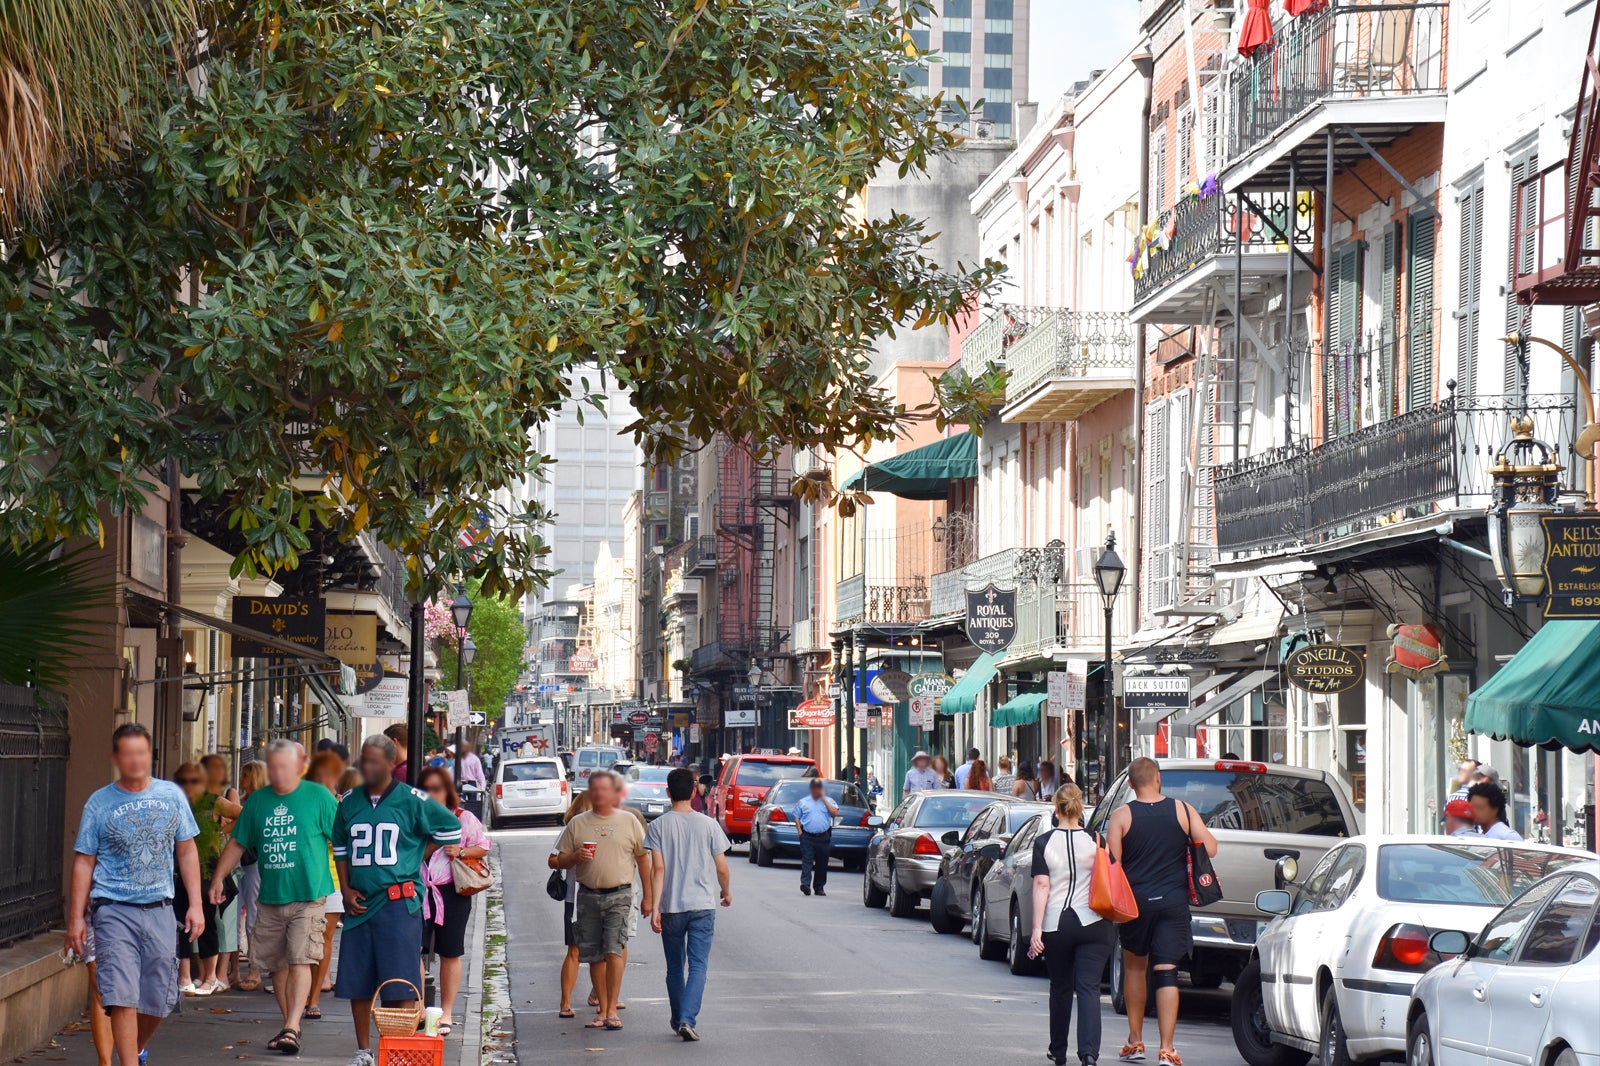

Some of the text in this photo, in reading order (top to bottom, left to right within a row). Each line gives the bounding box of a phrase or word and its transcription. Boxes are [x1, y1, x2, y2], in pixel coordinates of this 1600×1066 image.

[1563, 525, 1600, 542] KEIL'S
[250, 600, 309, 616] DAVID'S
[1570, 597, 1600, 607] 1899
[976, 605, 1007, 617] ROYAL
[970, 617, 1014, 631] ANTIQUES
[1297, 648, 1350, 665] O'NEILL
[1296, 666, 1353, 675] STUDIOS
[923, 677, 946, 686] MANN
[1127, 680, 1187, 690] JACK SUTTON
[1304, 677, 1342, 692] Fine Art
[913, 684, 952, 694] GALLERY
[113, 800, 170, 819] AFFLICTION
[265, 815, 294, 826] KEEP
[263, 825, 297, 837] CALM
[263, 841, 296, 853] CHIVE
[350, 822, 400, 866] 20
[269, 853, 286, 863] ON
